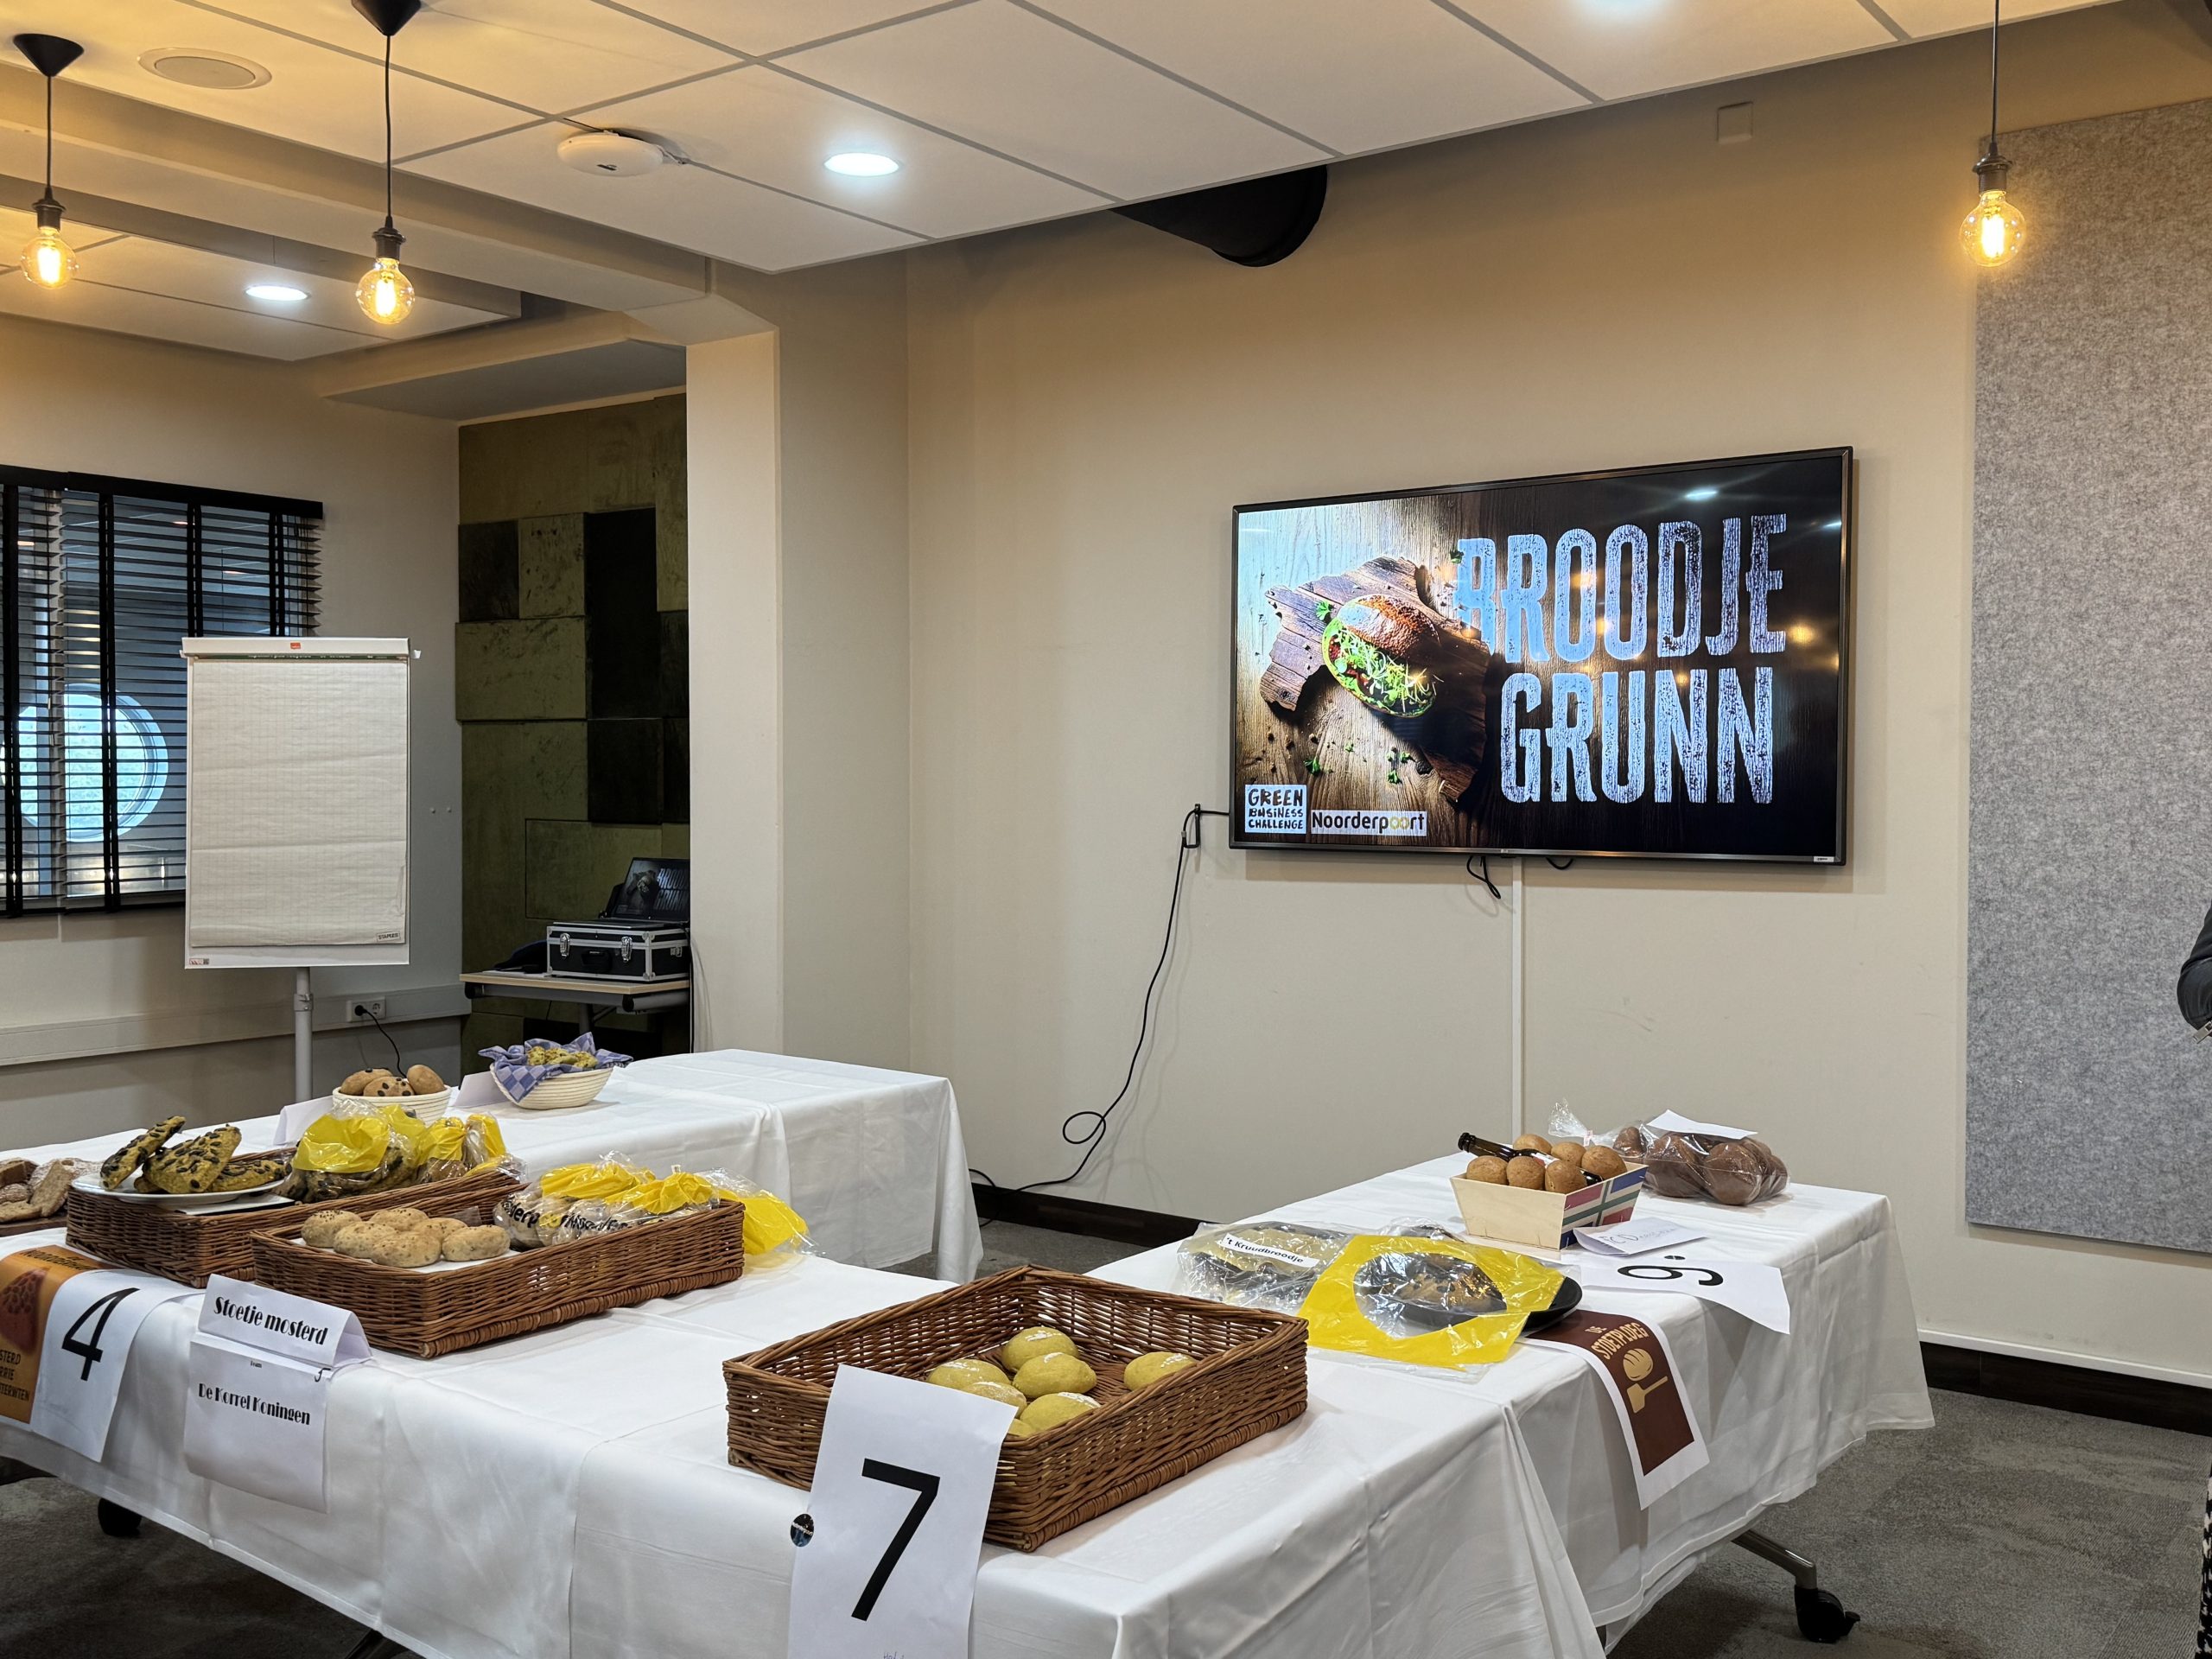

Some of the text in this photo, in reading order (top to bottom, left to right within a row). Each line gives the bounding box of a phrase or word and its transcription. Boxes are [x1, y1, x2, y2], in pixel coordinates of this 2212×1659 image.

[1452, 513, 1787, 664] BROODJE
[1500, 666, 1774, 804] GRUNN
[1248, 788, 1303, 806] GREEN
[1248, 819, 1304, 830] CHALLENGE
[1312, 811, 1425, 834] Noorderpoort
[1234, 1241, 1304, 1264] Kruudbroodje
[1617, 1265, 1724, 1287] 9
[61, 1287, 141, 1382] 4
[213, 1296, 328, 1345] Stoetje mosterd
[1591, 1322, 1649, 1360] STOETPLOEG
[199, 1382, 311, 1426] De Korrel Koningen
[850, 1457, 941, 1622] 7
